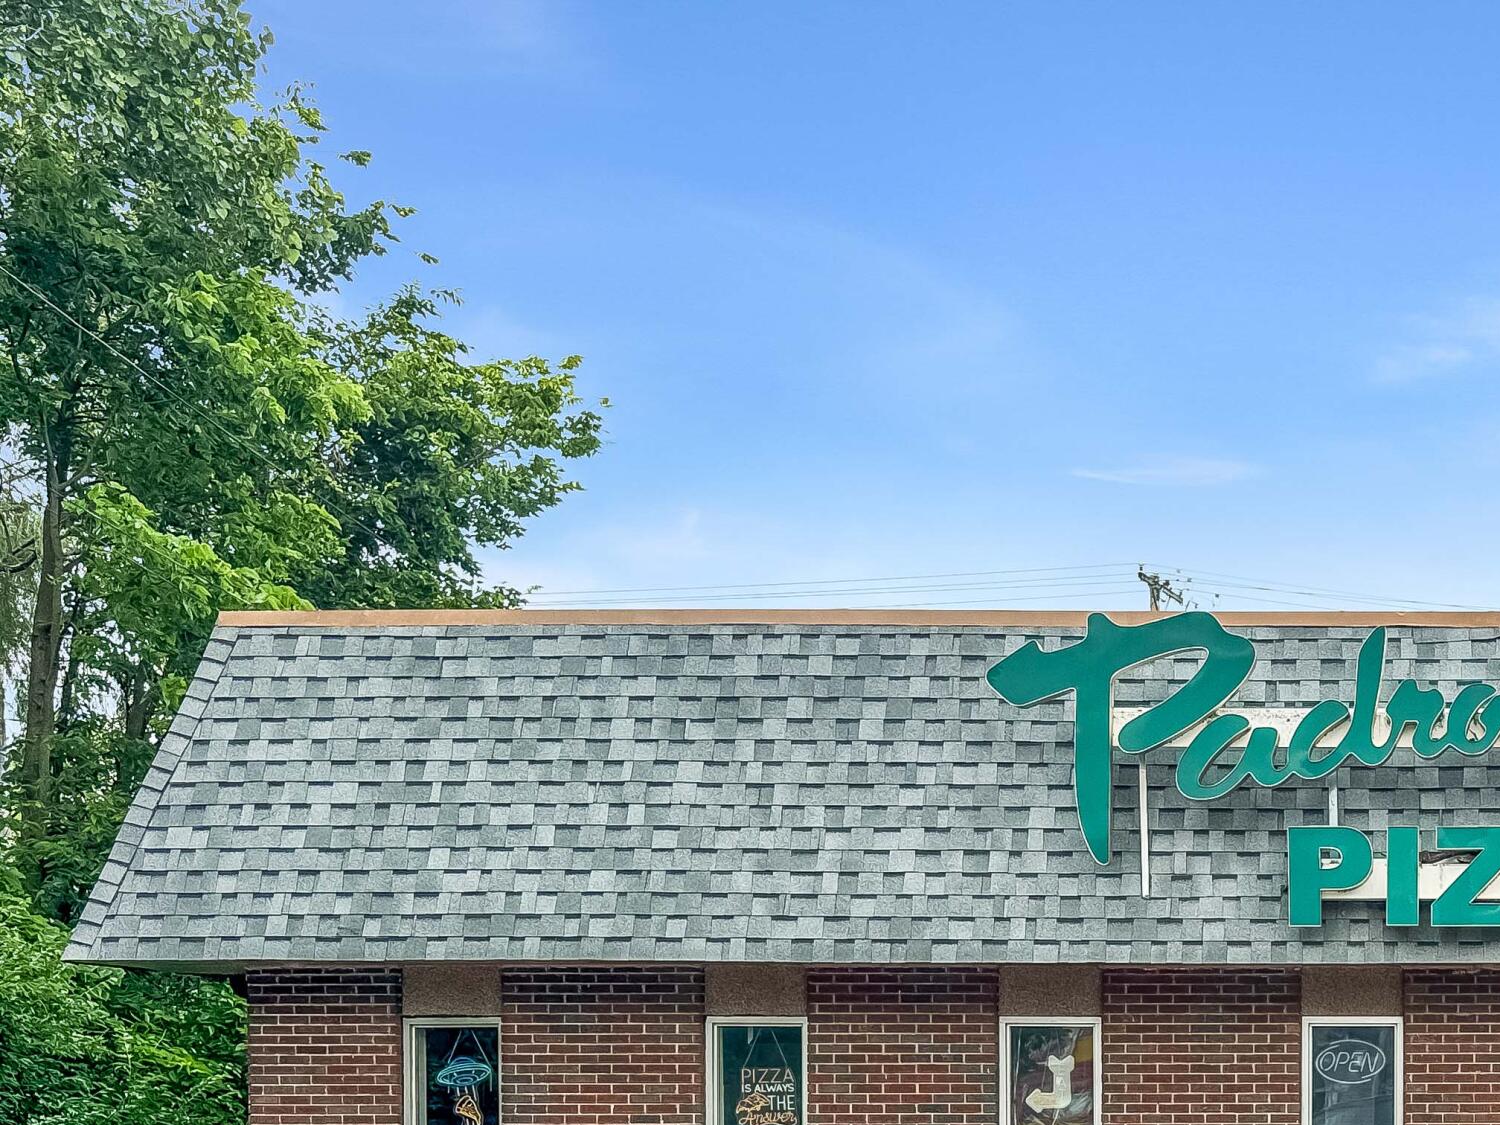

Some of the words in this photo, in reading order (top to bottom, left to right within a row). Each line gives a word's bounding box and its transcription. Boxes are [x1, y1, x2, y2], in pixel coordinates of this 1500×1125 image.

[1319, 1051, 1379, 1073] OPEN
[742, 1068, 795, 1083] PIZZA
[742, 1083, 752, 1093] IS
[754, 1083, 795, 1093] ALWAYS
[767, 1095, 796, 1111] THE
